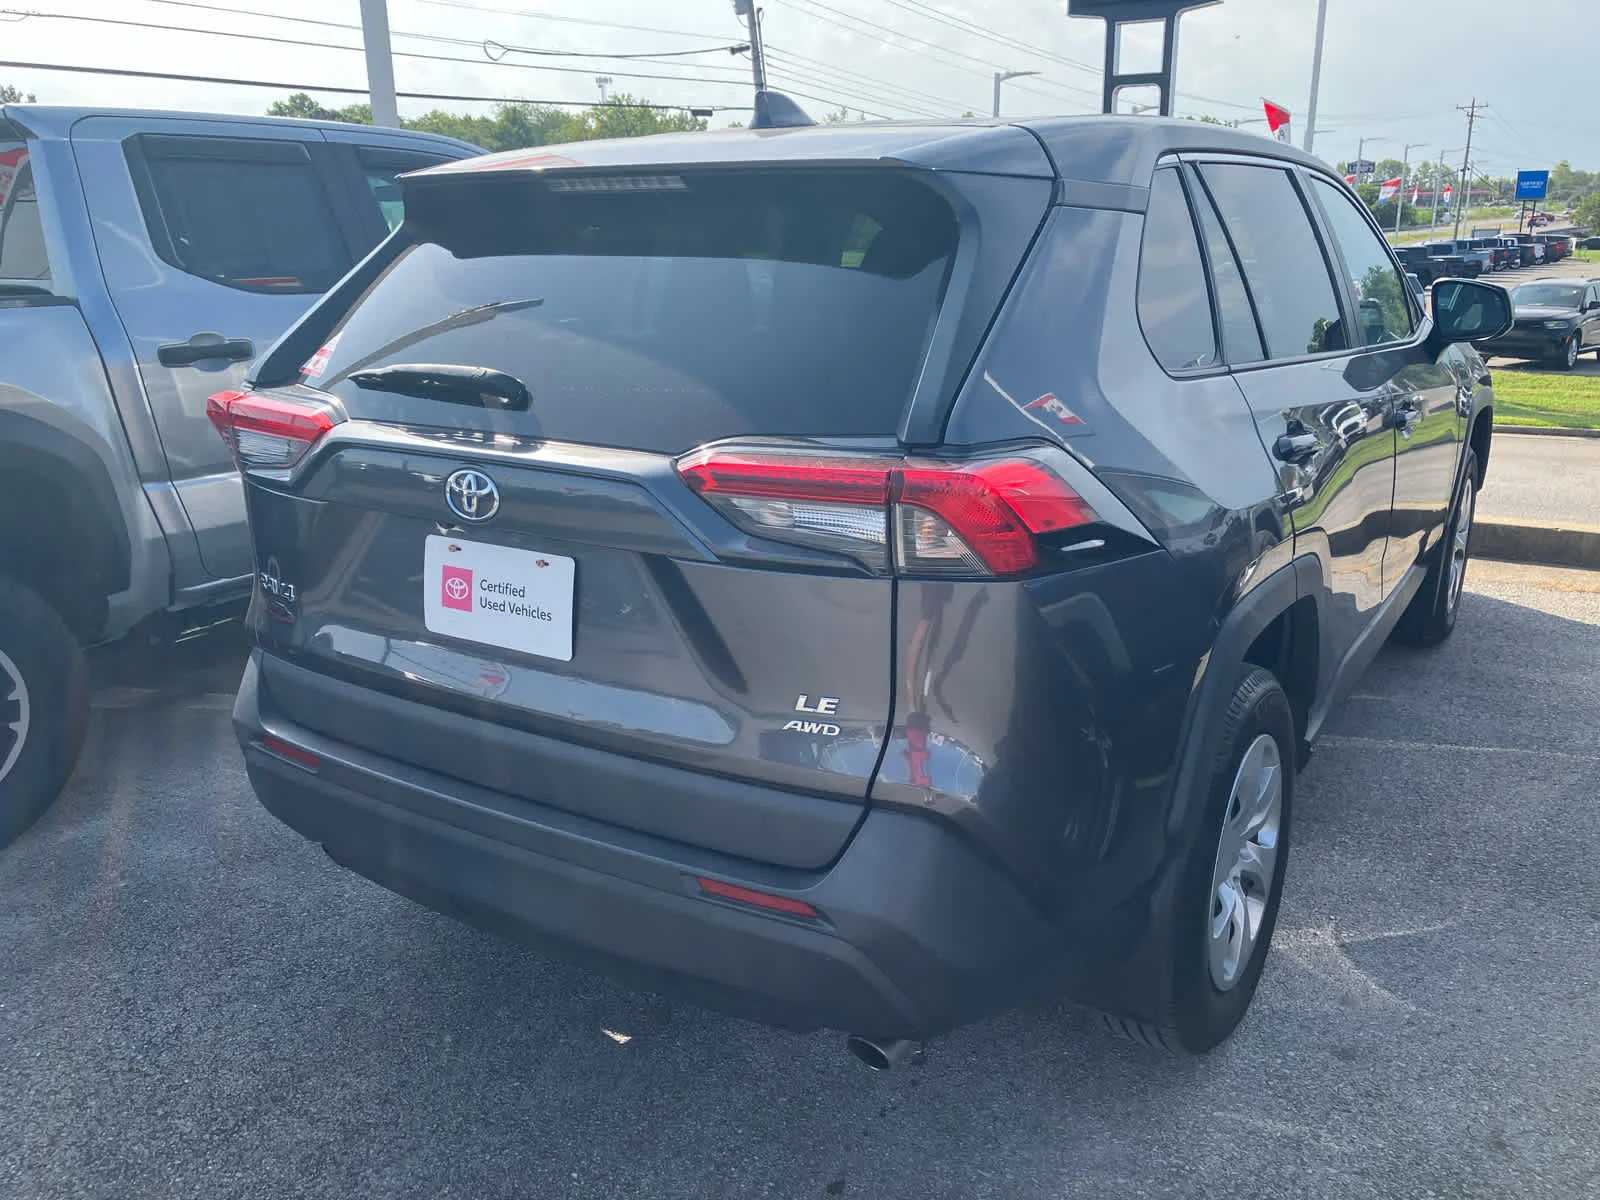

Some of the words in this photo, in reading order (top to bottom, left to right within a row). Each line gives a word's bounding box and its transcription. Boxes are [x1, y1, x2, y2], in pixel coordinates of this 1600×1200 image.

[479, 579, 526, 598] Certified
[479, 596, 506, 612] Used
[508, 602, 552, 622] Vehicles
[795, 693, 840, 715] LE
[782, 720, 841, 736] AWD
